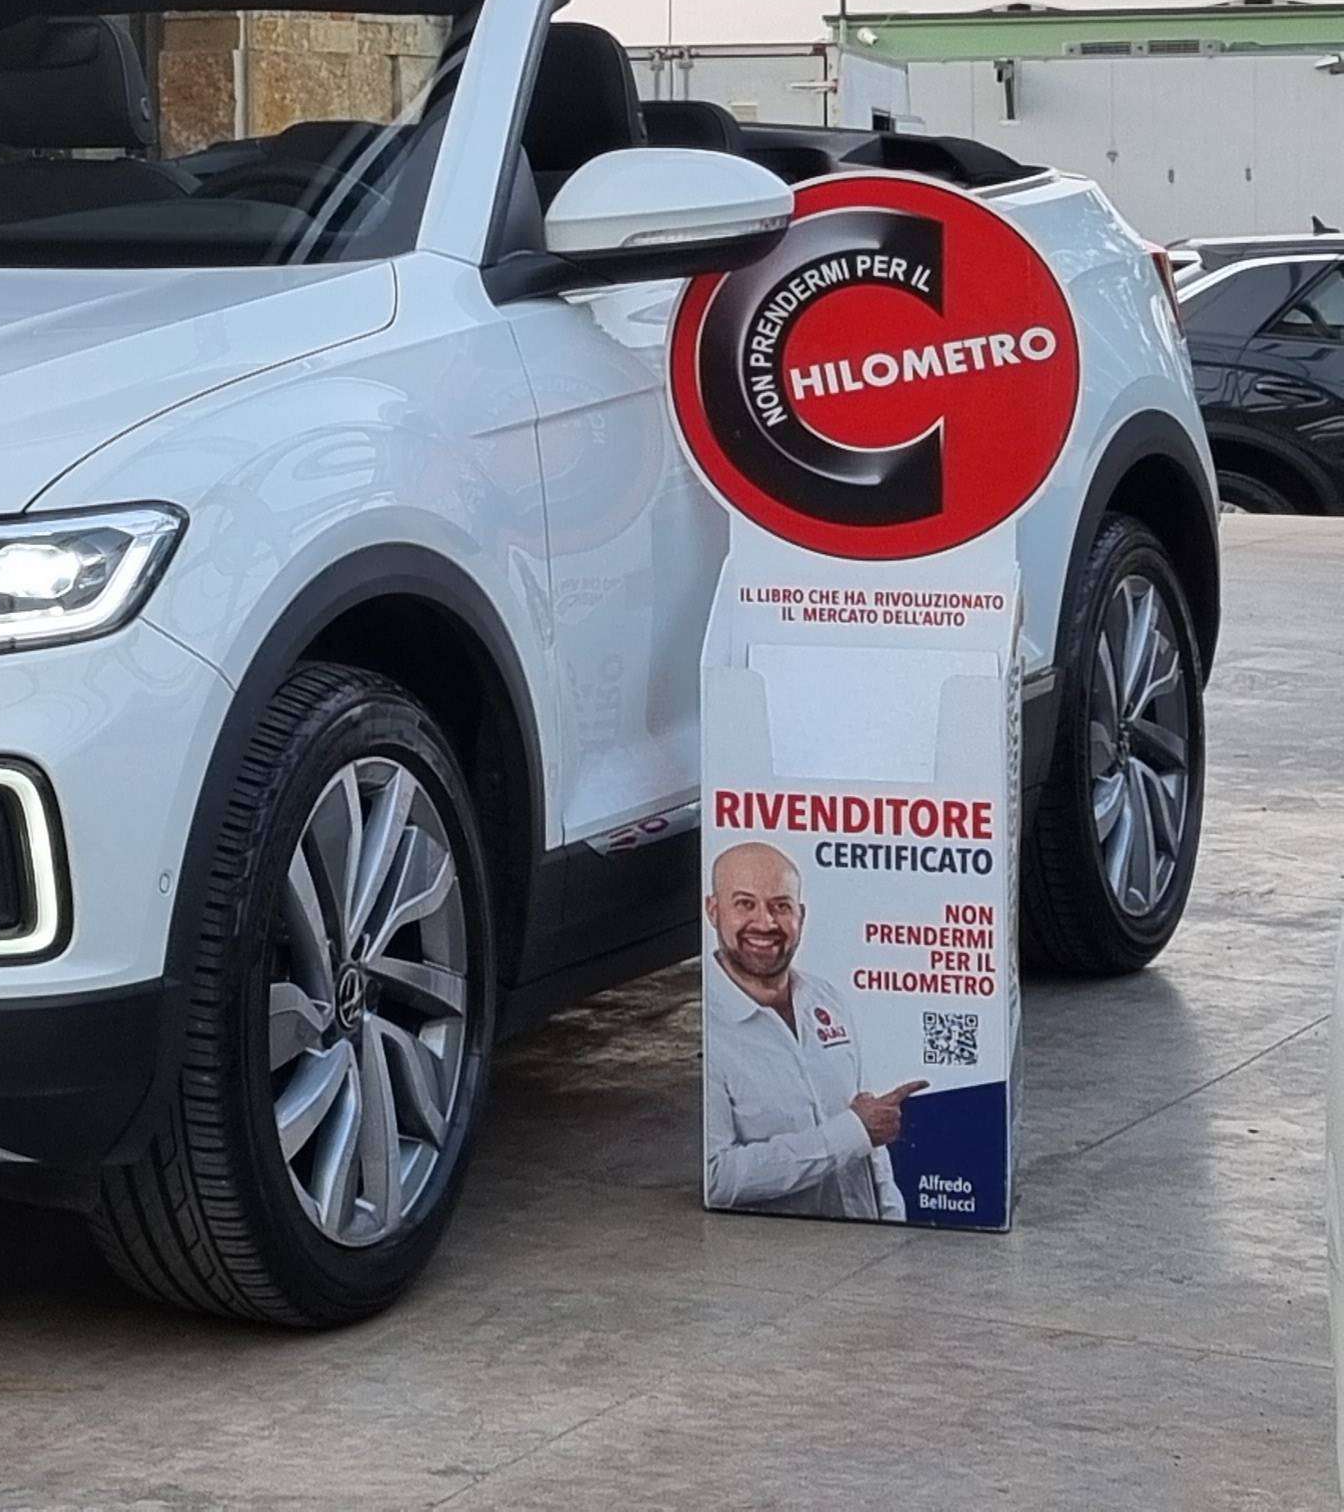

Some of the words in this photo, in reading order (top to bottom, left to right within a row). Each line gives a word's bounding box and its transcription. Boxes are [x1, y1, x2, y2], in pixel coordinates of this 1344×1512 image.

[856, 254, 908, 281] PER
[911, 264, 932, 293] IL
[750, 257, 849, 368] PRENDERMI
[750, 376, 788, 428] NON
[740, 588, 754, 602] IL
[757, 588, 804, 604] LIBRO
[808, 589, 839, 605] CHE
[844, 590, 866, 605] HA
[874, 591, 1004, 610] RIVOLUZIONATO
[782, 607, 795, 621] IL
[803, 608, 878, 624] MERCATO
[882, 609, 965, 627] DELL'AUTO
[715, 791, 993, 839] RIVENDITORE
[815, 842, 994, 875] CERTIFICATO
[945, 904, 994, 926] NON
[865, 924, 994, 950] PRENDERMI
[931, 950, 970, 972] PER
[977, 952, 996, 973] IL
[853, 969, 995, 997] CHILOMETRO
[918, 1175, 972, 1194] Alfredo
[919, 1194, 976, 1213] Bellucci
